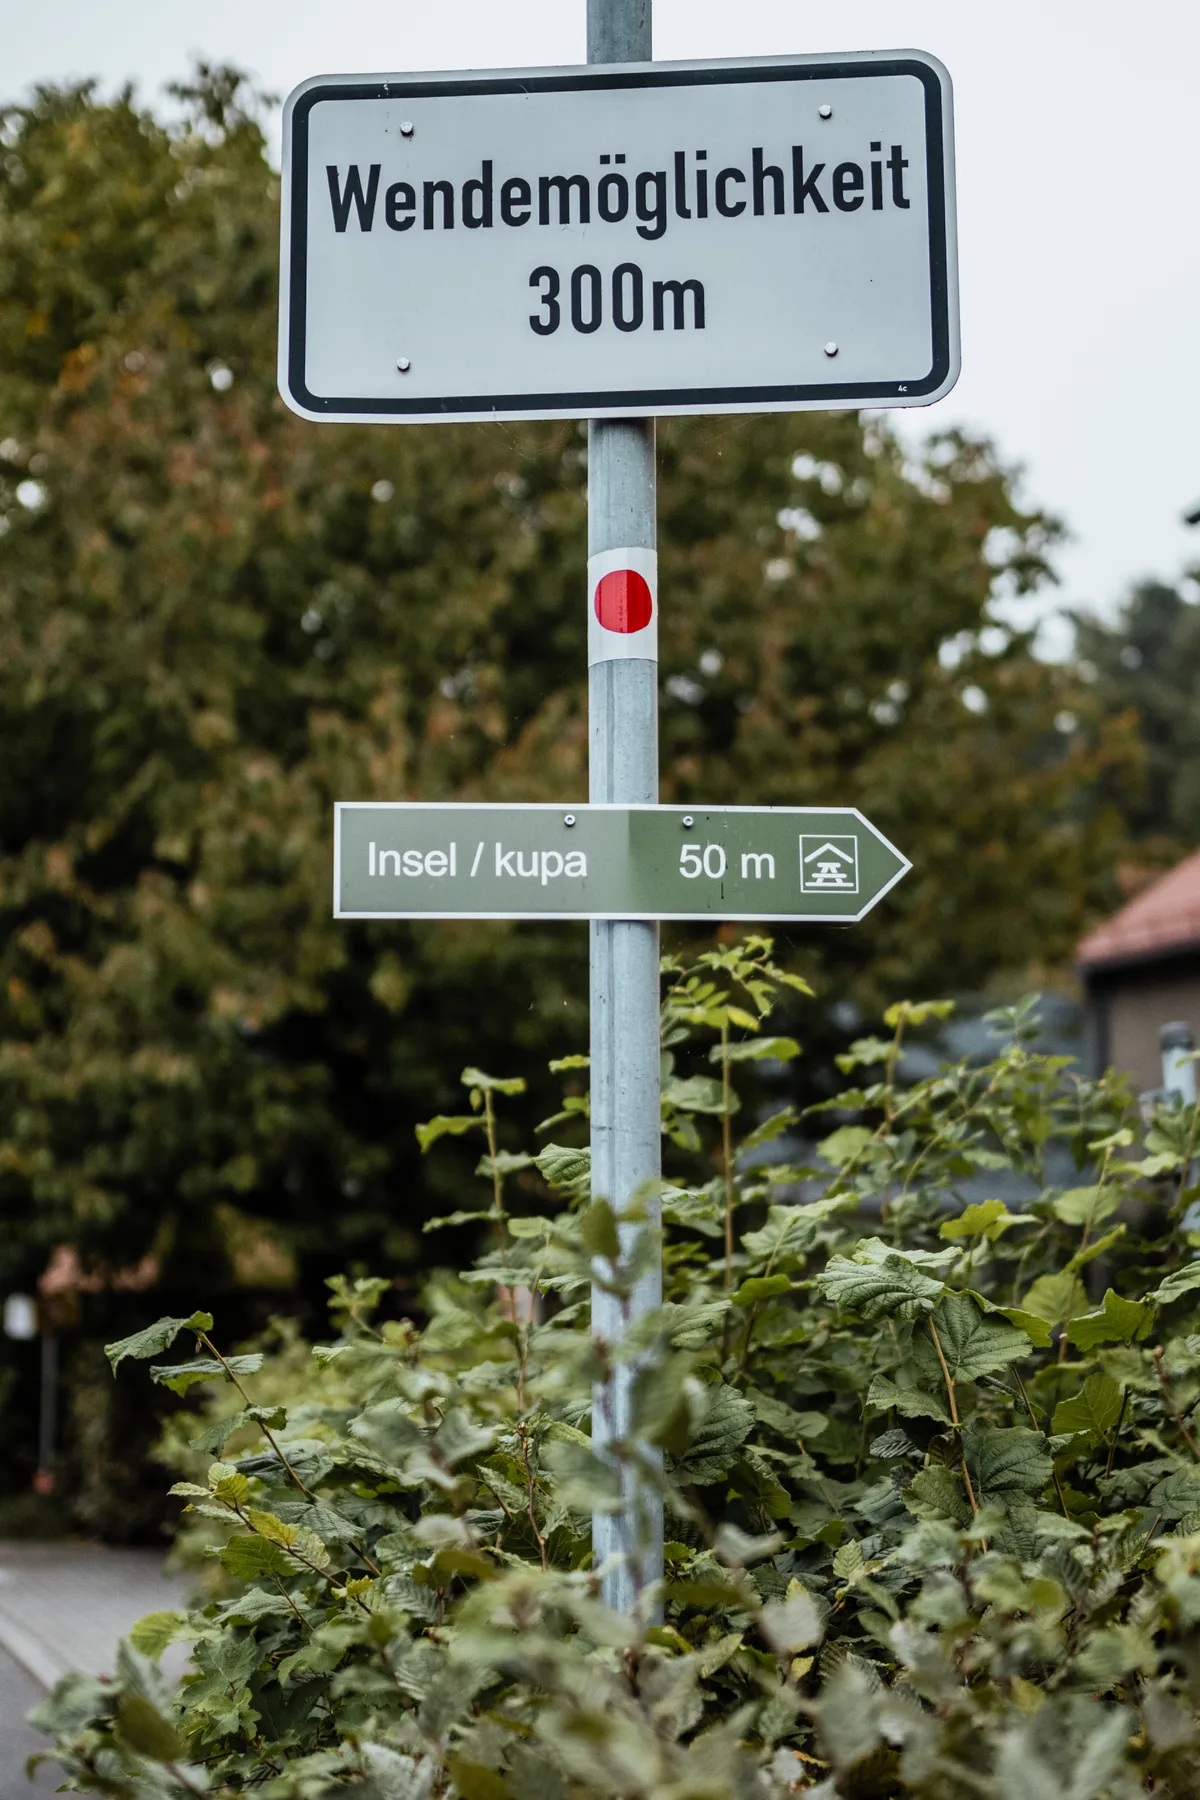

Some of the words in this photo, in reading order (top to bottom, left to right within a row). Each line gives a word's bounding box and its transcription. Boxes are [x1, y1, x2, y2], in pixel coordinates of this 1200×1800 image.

[325, 141, 911, 241] Wendemöglichkeit
[528, 262, 706, 336] 300m
[368, 841, 457, 877] Insel
[470, 841, 485, 877] /
[495, 842, 588, 886] kupa
[679, 844, 727, 879] 50
[741, 852, 776, 879] m
